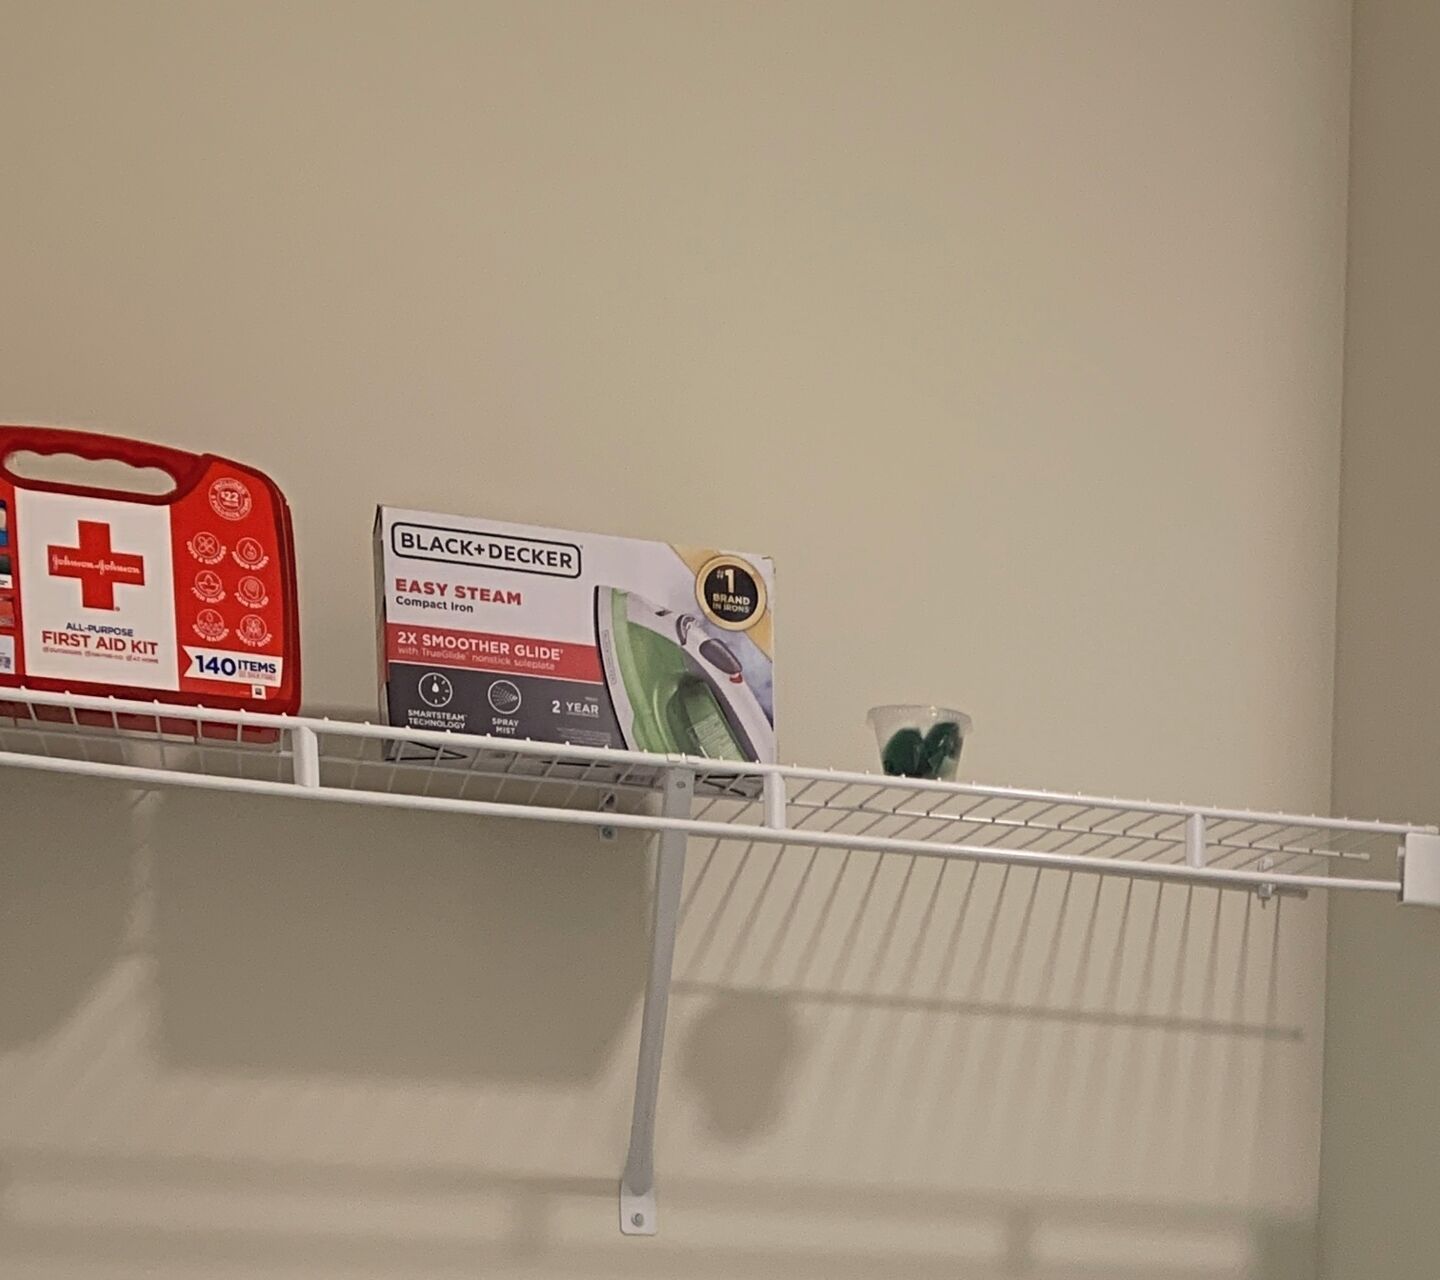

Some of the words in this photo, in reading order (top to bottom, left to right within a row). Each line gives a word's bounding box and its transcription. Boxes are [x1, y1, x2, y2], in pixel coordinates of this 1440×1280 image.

[401, 532, 573, 569] BLACK+DECKER
[716, 568, 735, 593] #1
[395, 578, 448, 597] EASY
[454, 585, 522, 606] STEAM
[712, 593, 750, 606] BRAND
[395, 596, 448, 611] Compact
[450, 601, 474, 613] Iron
[723, 604, 750, 613] IRONS
[66, 622, 134, 637] ALL-PURPOSE
[42, 631, 92, 648] FIRST
[96, 636, 127, 652] AID
[131, 640, 159, 656] KIT
[397, 631, 418, 645] 2X
[422, 634, 510, 655] SMOOTHER
[195, 654, 237, 677] 140
[238, 660, 277, 674] ITEMS
[397, 646, 419, 656] with
[472, 653, 511, 666] nonstick
[513, 659, 556, 672] soleplate
[551, 700, 561, 713] 2
[566, 702, 600, 714] YEAR
[408, 717, 466, 730] TECHNOLOGY
[491, 717, 519, 728] SPRAY
[495, 726, 516, 735] MIST
